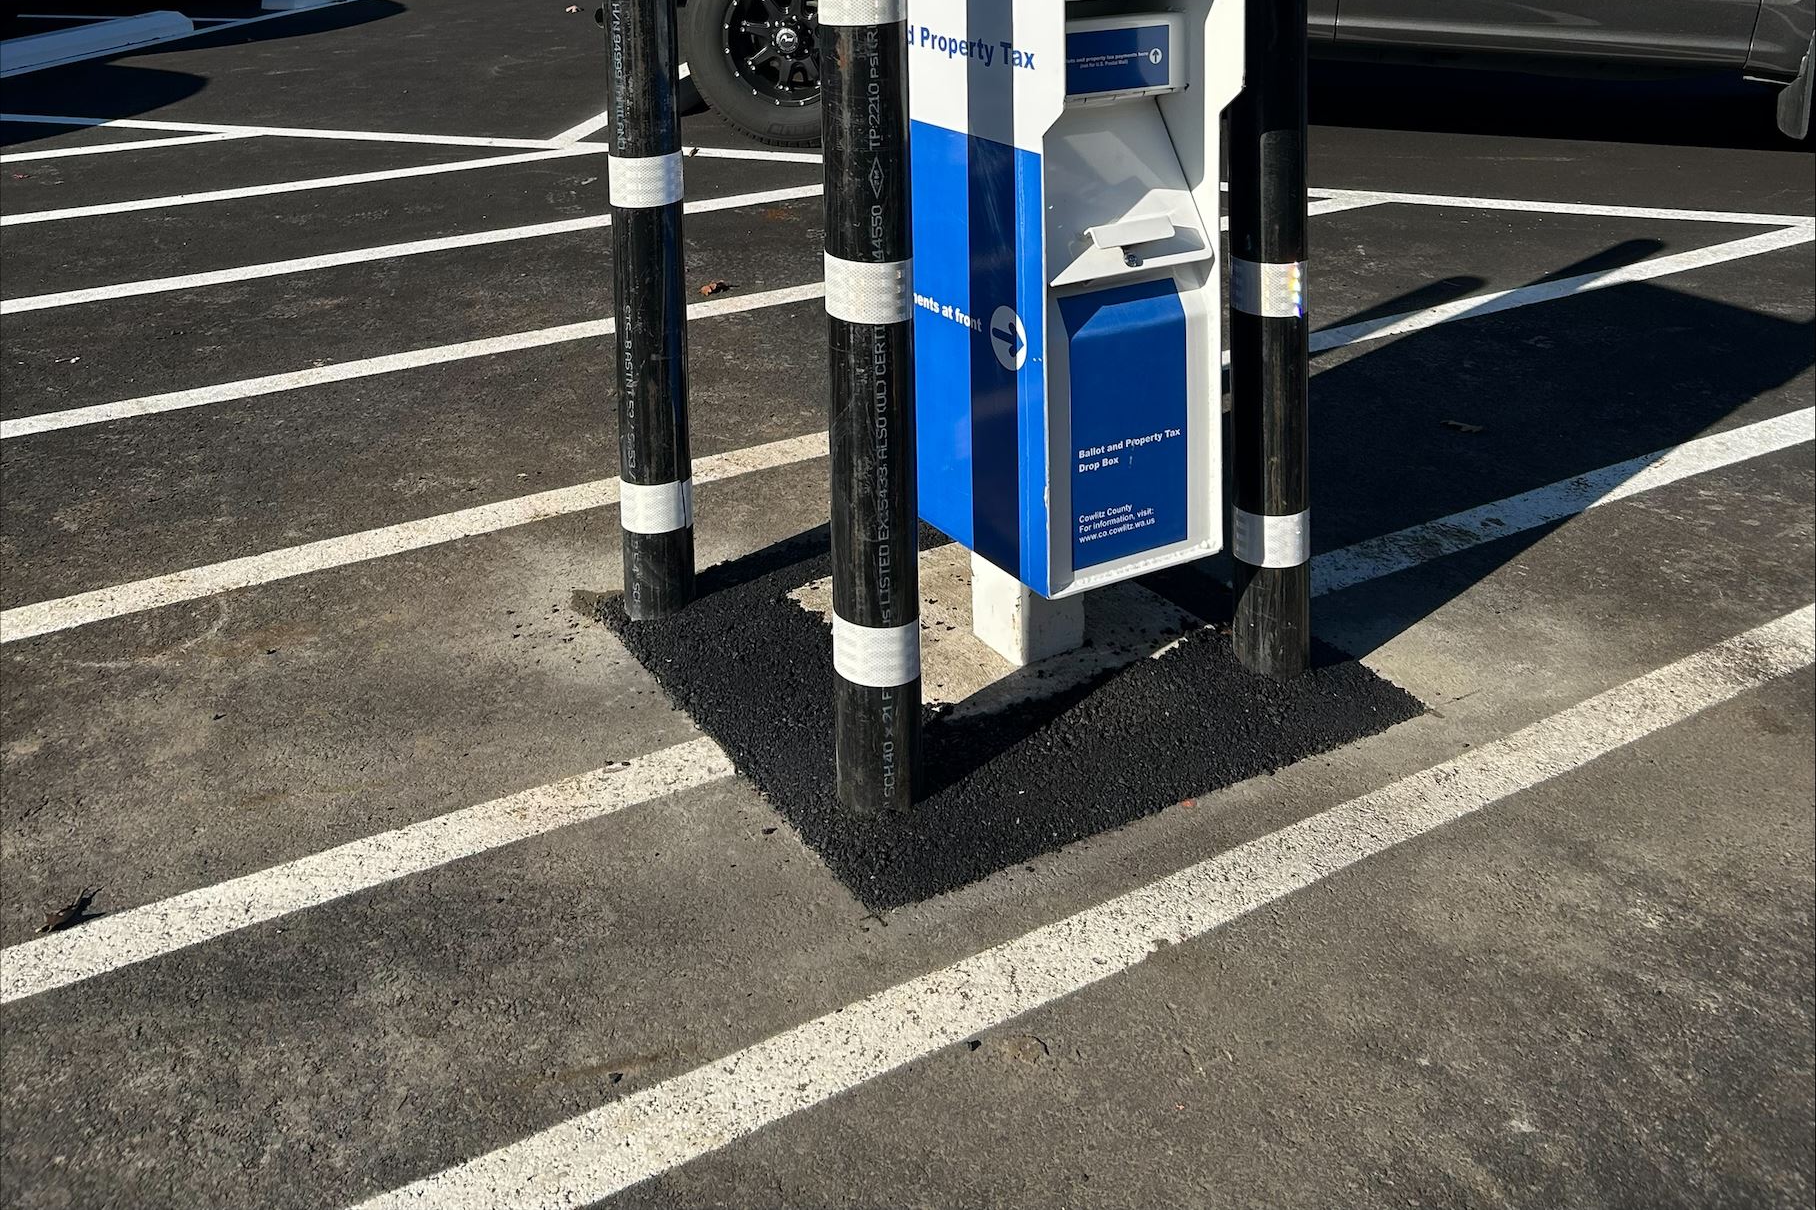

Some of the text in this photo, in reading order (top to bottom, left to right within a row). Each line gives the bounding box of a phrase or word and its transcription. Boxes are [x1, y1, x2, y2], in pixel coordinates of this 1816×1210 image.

[920, 26, 995, 67] Property
[1000, 41, 1035, 70] Tax
[941, 304, 953, 320] at
[955, 307, 982, 333] front
[1078, 428, 1181, 459] Ballot and Property Tax
[1078, 456, 1120, 473] Drop Box
[1078, 503, 1133, 523] Cowlitz County
[1079, 524, 1092, 533] For
